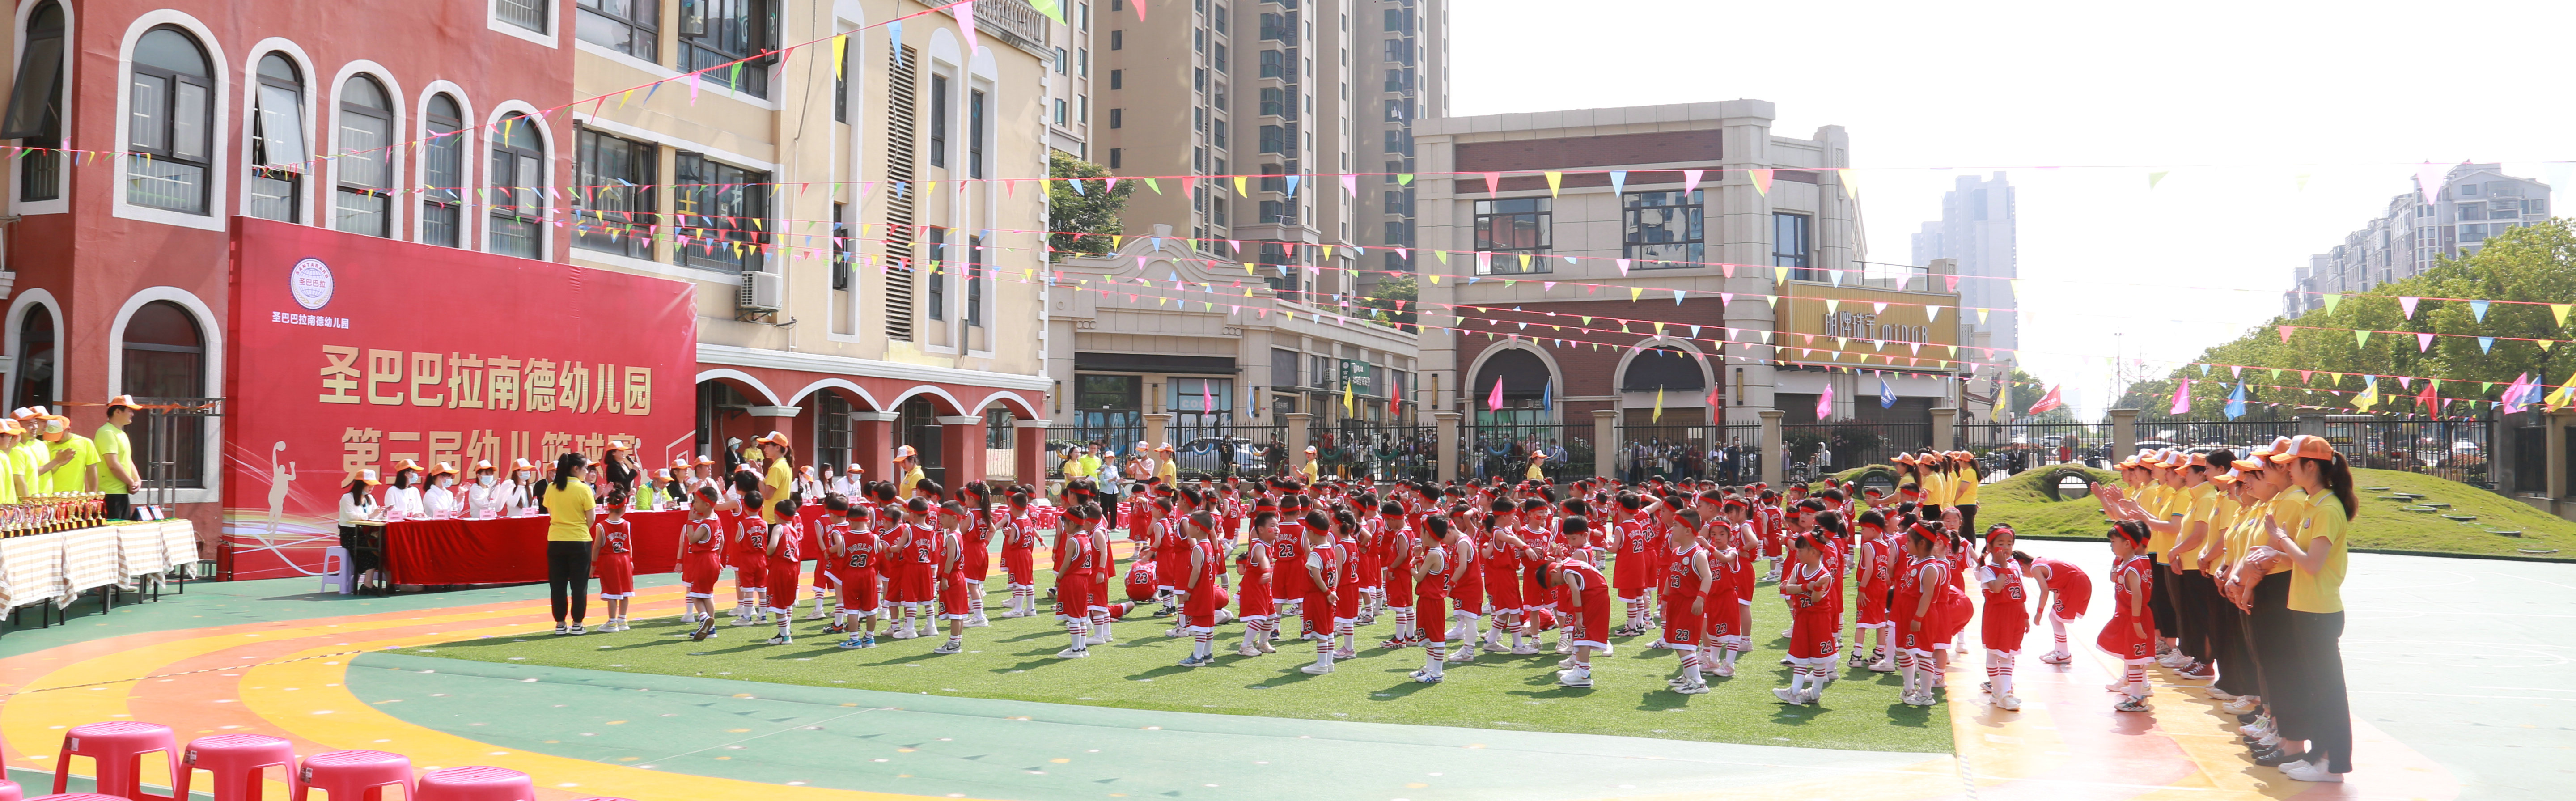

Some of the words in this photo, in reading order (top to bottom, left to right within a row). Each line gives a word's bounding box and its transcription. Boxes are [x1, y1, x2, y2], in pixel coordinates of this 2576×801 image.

[299, 277, 326, 288] 圣巴巴拉
[272, 311, 349, 329] 圣巴巴拉南德幼儿园
[1826, 311, 1876, 343] 明牌珠宝
[319, 344, 652, 416] 圣巴巴拉南德幼儿园
[878, 529, 885, 539] 2
[1642, 526, 1655, 543] 23
[751, 535, 763, 548] 23
[1377, 535, 1383, 547] 2
[1633, 538, 1644, 554] 23
[847, 543, 873, 553] DSKLR
[1279, 543, 1295, 558] 23
[849, 554, 868, 568] 23
[1135, 572, 1148, 584] 23
[1711, 568, 1721, 581] 23
[1443, 574, 1450, 590] 2
[1670, 575, 1680, 588] 23
[2009, 586, 2021, 599] 23
[939, 601, 946, 612] 3
[1056, 602, 1063, 612] 3
[1565, 614, 1573, 624] 23
[1574, 630, 1585, 639] 23
[1675, 629, 1690, 641] 23
[1716, 622, 1727, 635] 23
[1820, 640, 1833, 654] 23
